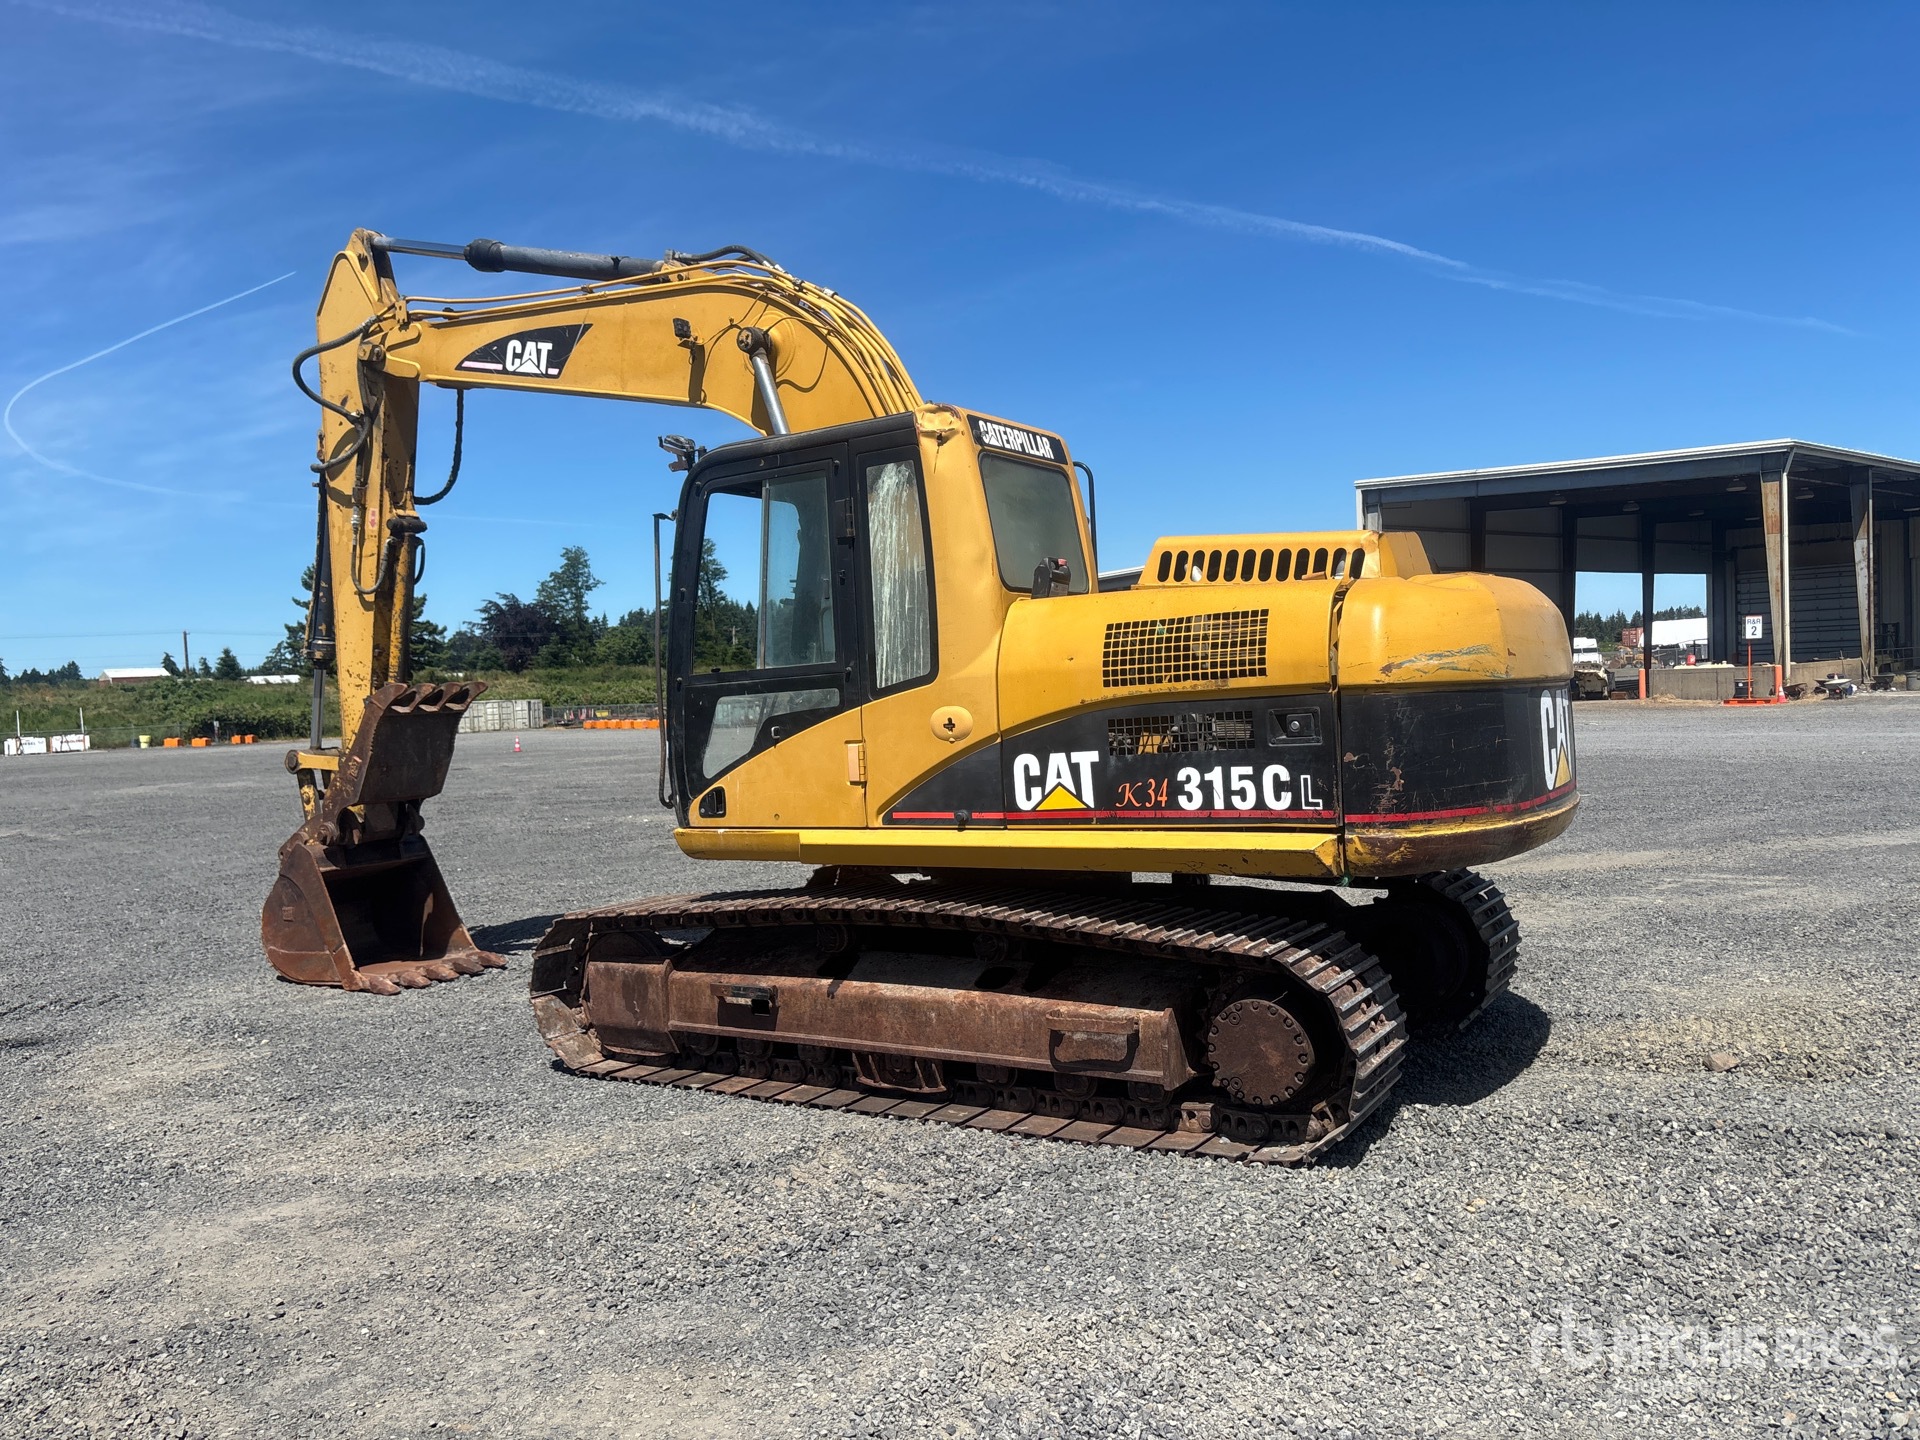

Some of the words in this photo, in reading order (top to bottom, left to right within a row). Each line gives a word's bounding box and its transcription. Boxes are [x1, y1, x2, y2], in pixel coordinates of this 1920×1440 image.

[505, 339, 553, 374] CAT
[978, 420, 1054, 459] CATERPILLAR
[1751, 625, 1757, 636] 2
[1540, 688, 1573, 791] CAT
[1013, 750, 1100, 811] CAT
[1115, 777, 1168, 808] K34
[1177, 764, 1292, 811] 315C
[1300, 774, 1323, 810] L
